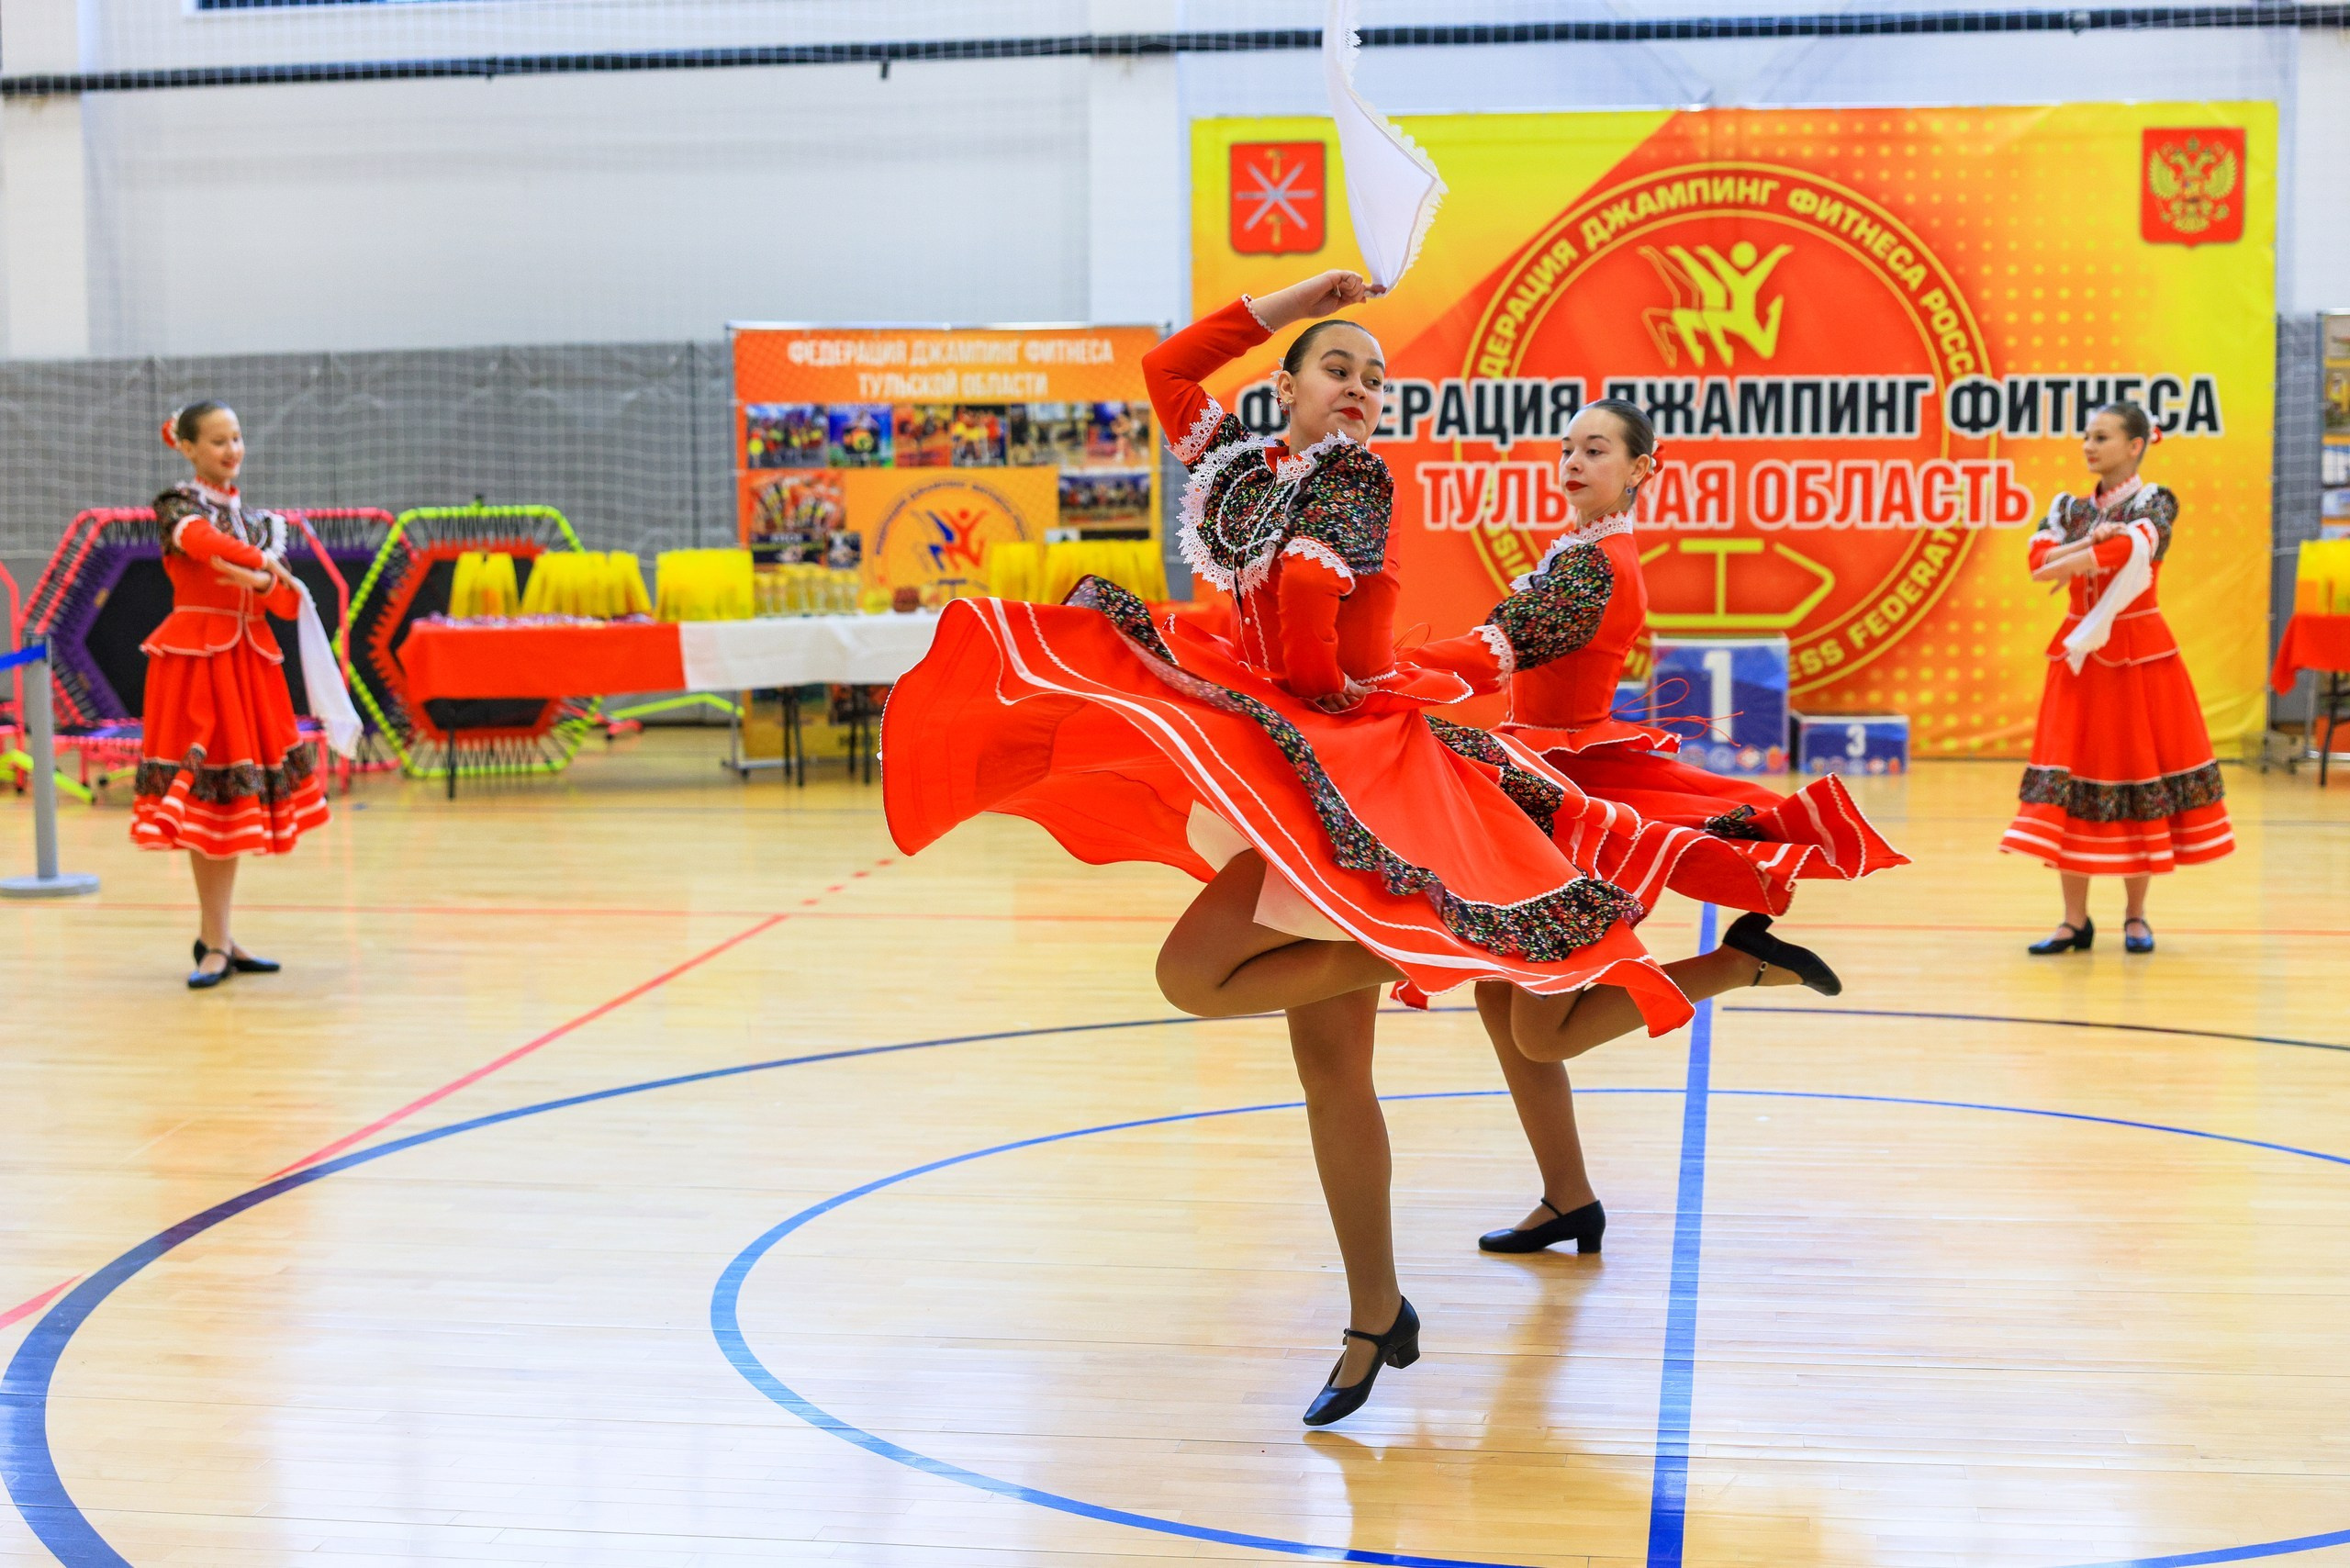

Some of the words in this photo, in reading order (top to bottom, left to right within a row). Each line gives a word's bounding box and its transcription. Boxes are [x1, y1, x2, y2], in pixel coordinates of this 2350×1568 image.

[1476, 237, 1579, 379] ДЕРАЦИЯ
[1579, 175, 1780, 252] ДЖАМПИНГ
[1787, 188, 1928, 292] ФИТНЕСА
[787, 340, 907, 367] ФЕДЕРАЦИЯ
[911, 341, 1021, 366] ДЖАМПИНГ
[1024, 340, 1114, 364] ФИТНЕСА
[858, 370, 957, 398] ТУЛЬСКОЙ
[961, 373, 1047, 396] ОБЛАСТИ
[1241, 383, 1580, 446] ФЕРАЦИЯ
[1423, 465, 1731, 525] ТУЛЬАЯ
[1754, 465, 2029, 525] ОБЛАСТЬ
[1703, 649, 1733, 744] 1
[1845, 724, 1867, 757] 3
